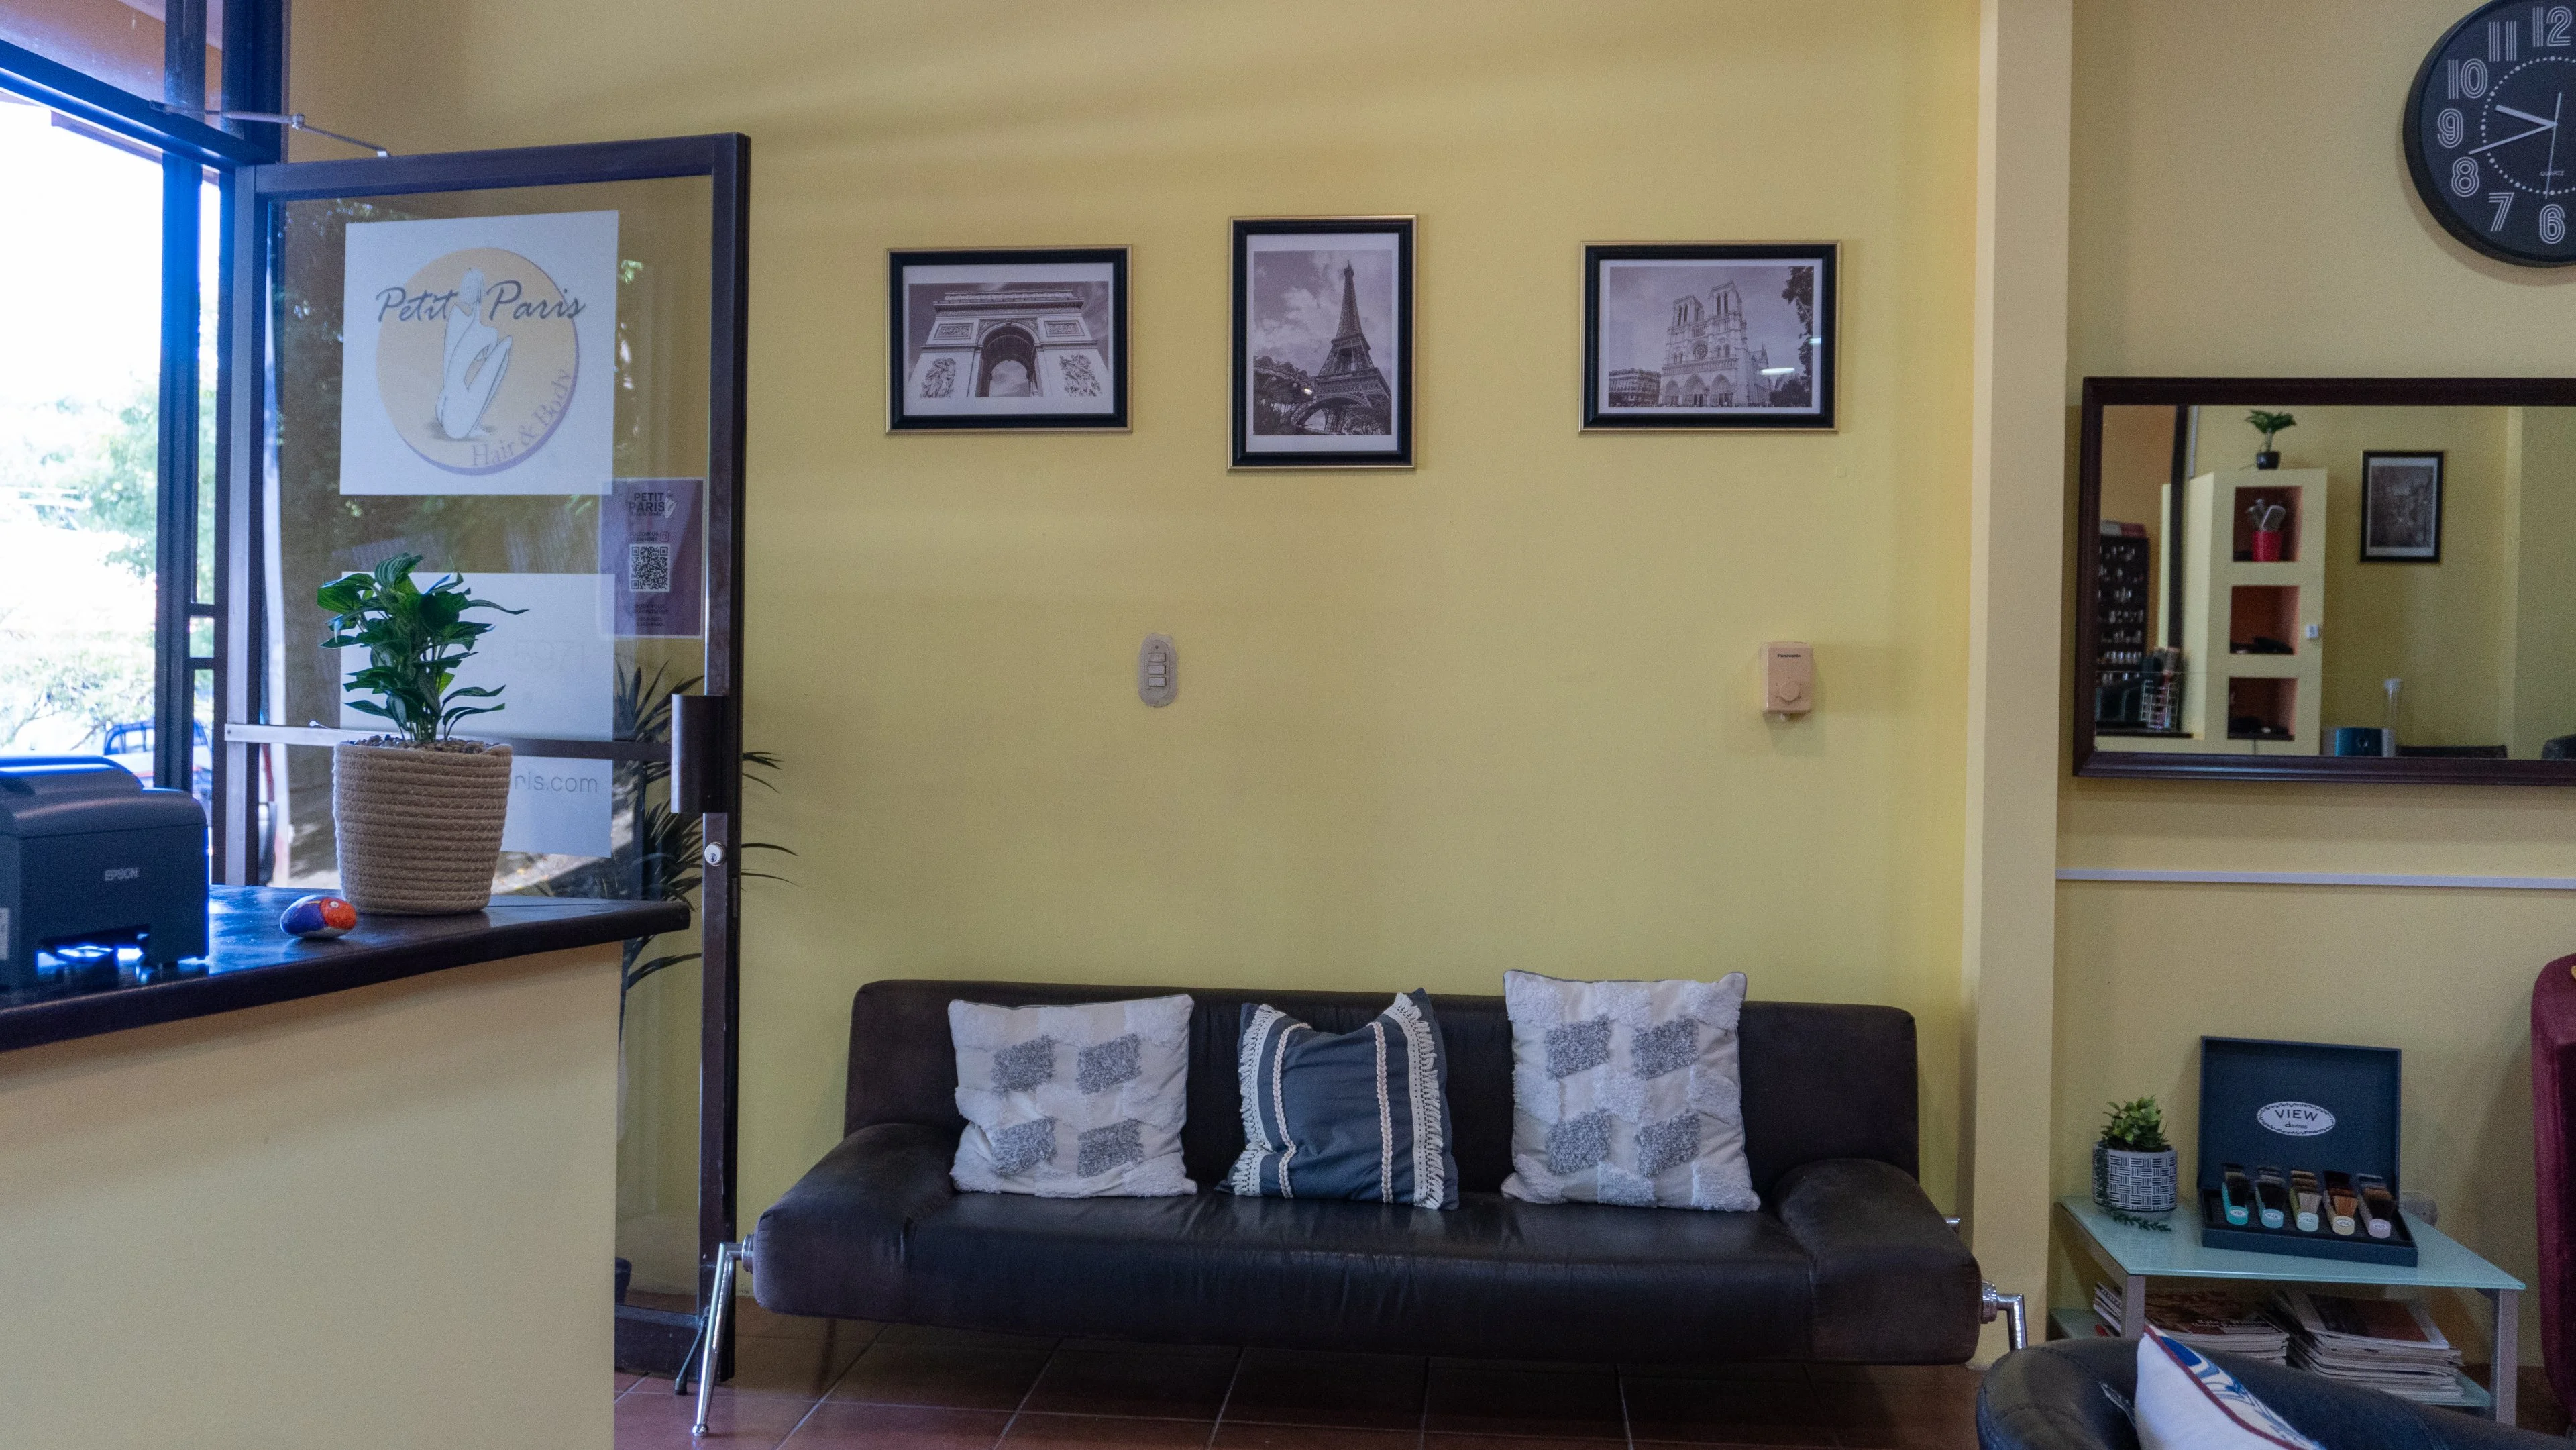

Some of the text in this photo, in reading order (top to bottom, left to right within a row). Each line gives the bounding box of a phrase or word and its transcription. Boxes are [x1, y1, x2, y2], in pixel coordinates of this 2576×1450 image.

[2488, 21, 2516, 62] 11
[2533, 6, 2572, 47] 12
[2448, 58, 2487, 99] 10
[2438, 108, 2463, 148] 9
[2451, 156, 2479, 197] 8
[2489, 192, 2515, 231] 7
[2539, 204, 2565, 244] 6
[376, 280, 586, 322] Petit Paris
[472, 369, 572, 466] Hair & Body
[628, 501, 665, 511] PARIS
[634, 492, 663, 501] PETIT
[514, 771, 598, 793] ris.com
[105, 867, 138, 882] EPSON
[2275, 1109, 2318, 1121] VIEW
